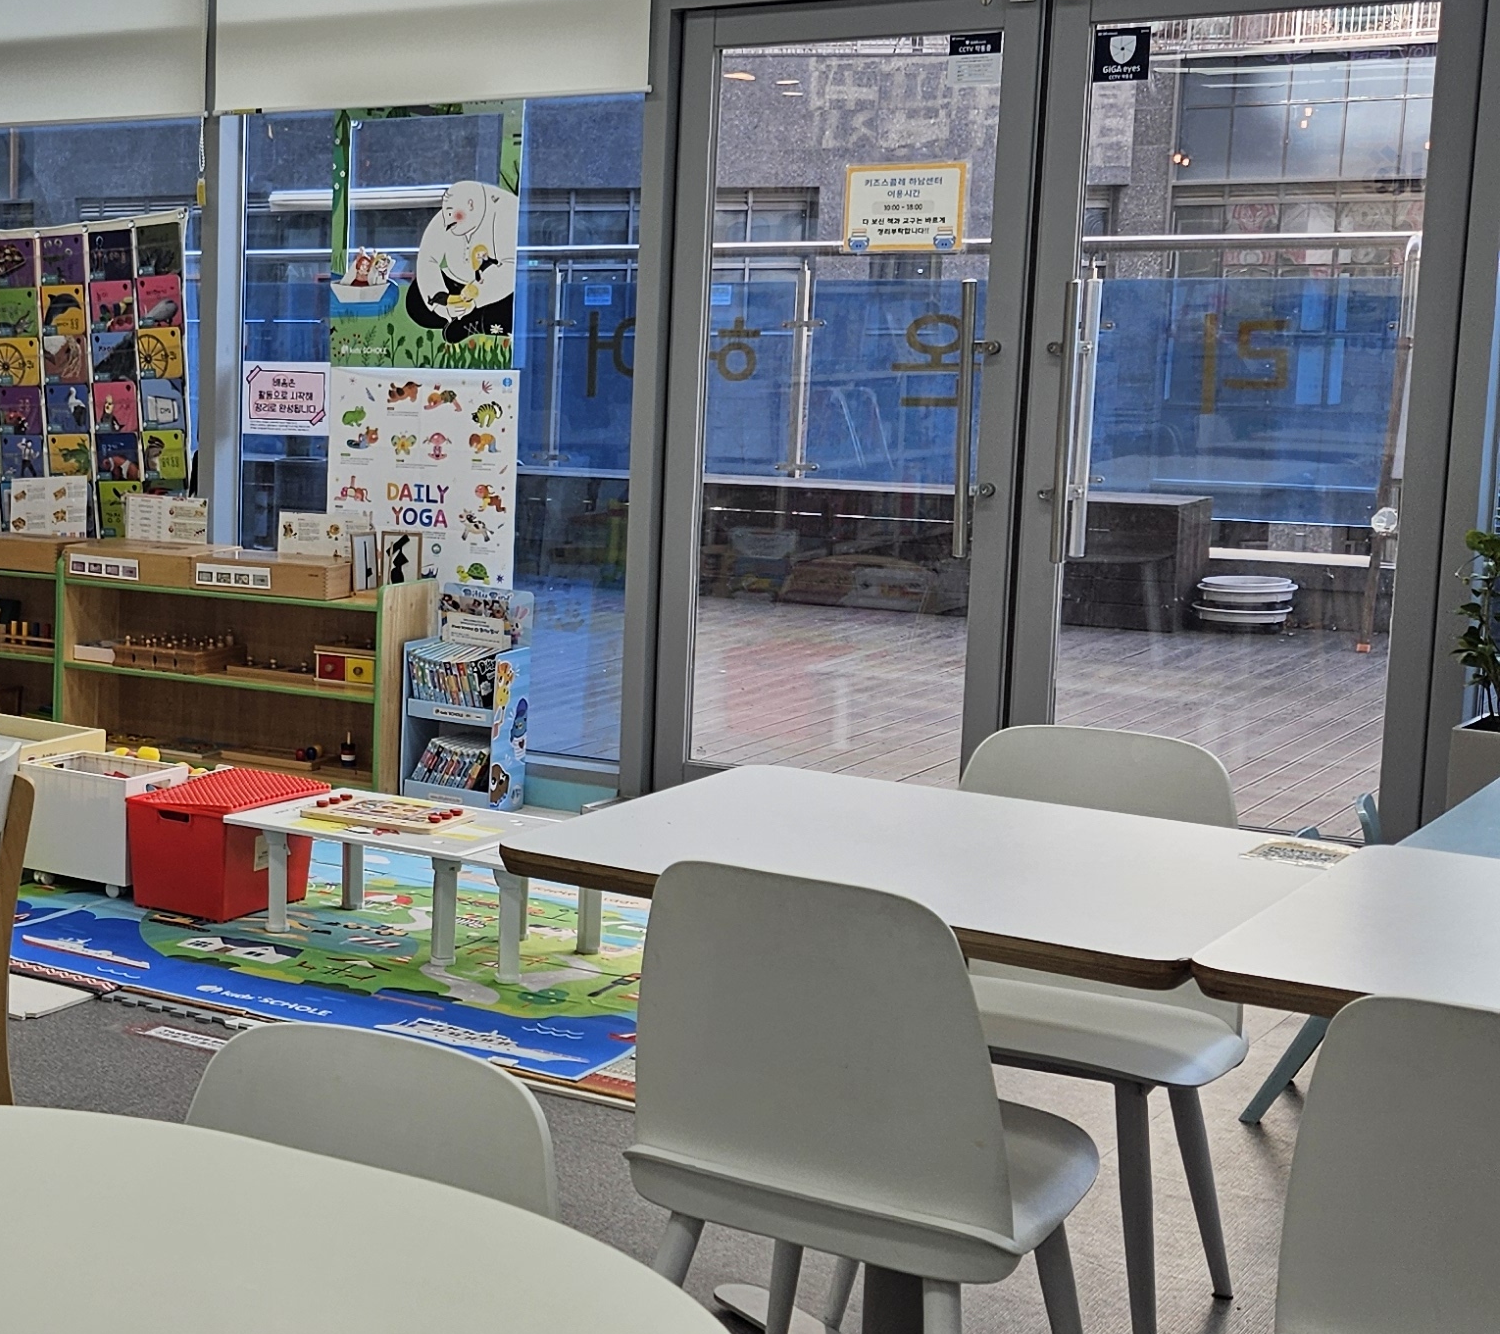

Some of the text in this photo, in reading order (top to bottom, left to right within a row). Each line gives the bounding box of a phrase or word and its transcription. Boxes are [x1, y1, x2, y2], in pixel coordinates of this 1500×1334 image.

[1123, 65, 1141, 74] eyes
[865, 176, 943, 187] 키즈스콜레 하남센터
[871, 217, 885, 225] 보신
[258, 390, 314, 401] 활동으로 시작해
[254, 402, 277, 413] 정리로
[386, 482, 449, 504] DAILY
[391, 505, 448, 529] YOGA
[259, 997, 333, 1016] SCHOLE
